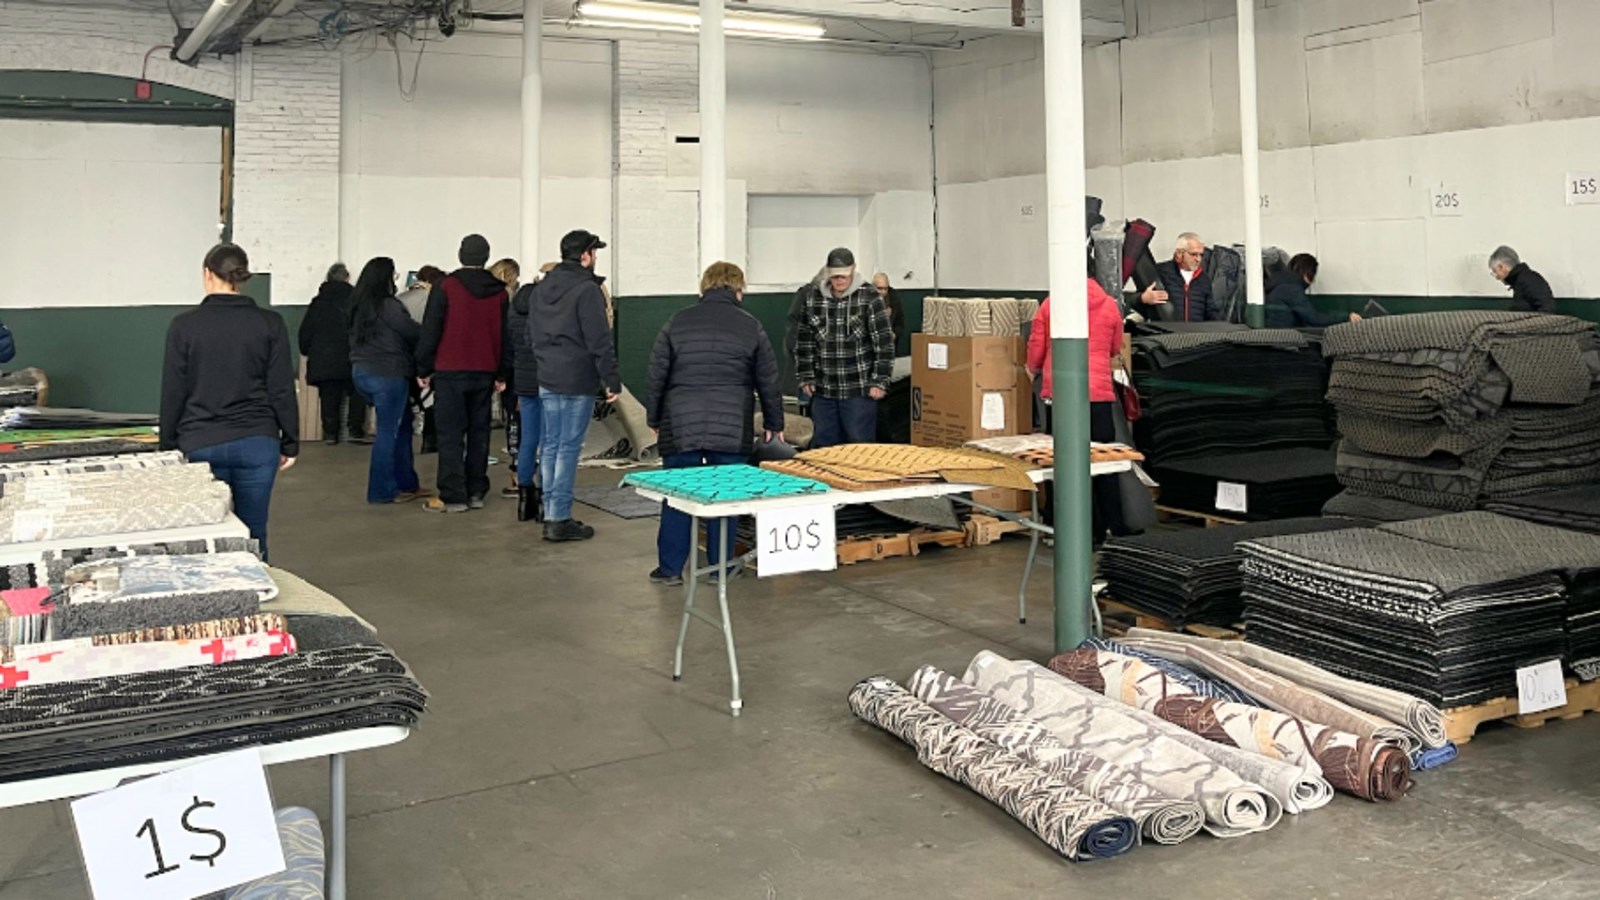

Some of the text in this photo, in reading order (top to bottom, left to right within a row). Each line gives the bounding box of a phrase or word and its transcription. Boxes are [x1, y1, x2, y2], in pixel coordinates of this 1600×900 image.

[1572, 178, 1597, 194] 15$
[1434, 193, 1460, 208] 20$
[769, 519, 821, 553] 10$
[135, 795, 226, 879] 1$
